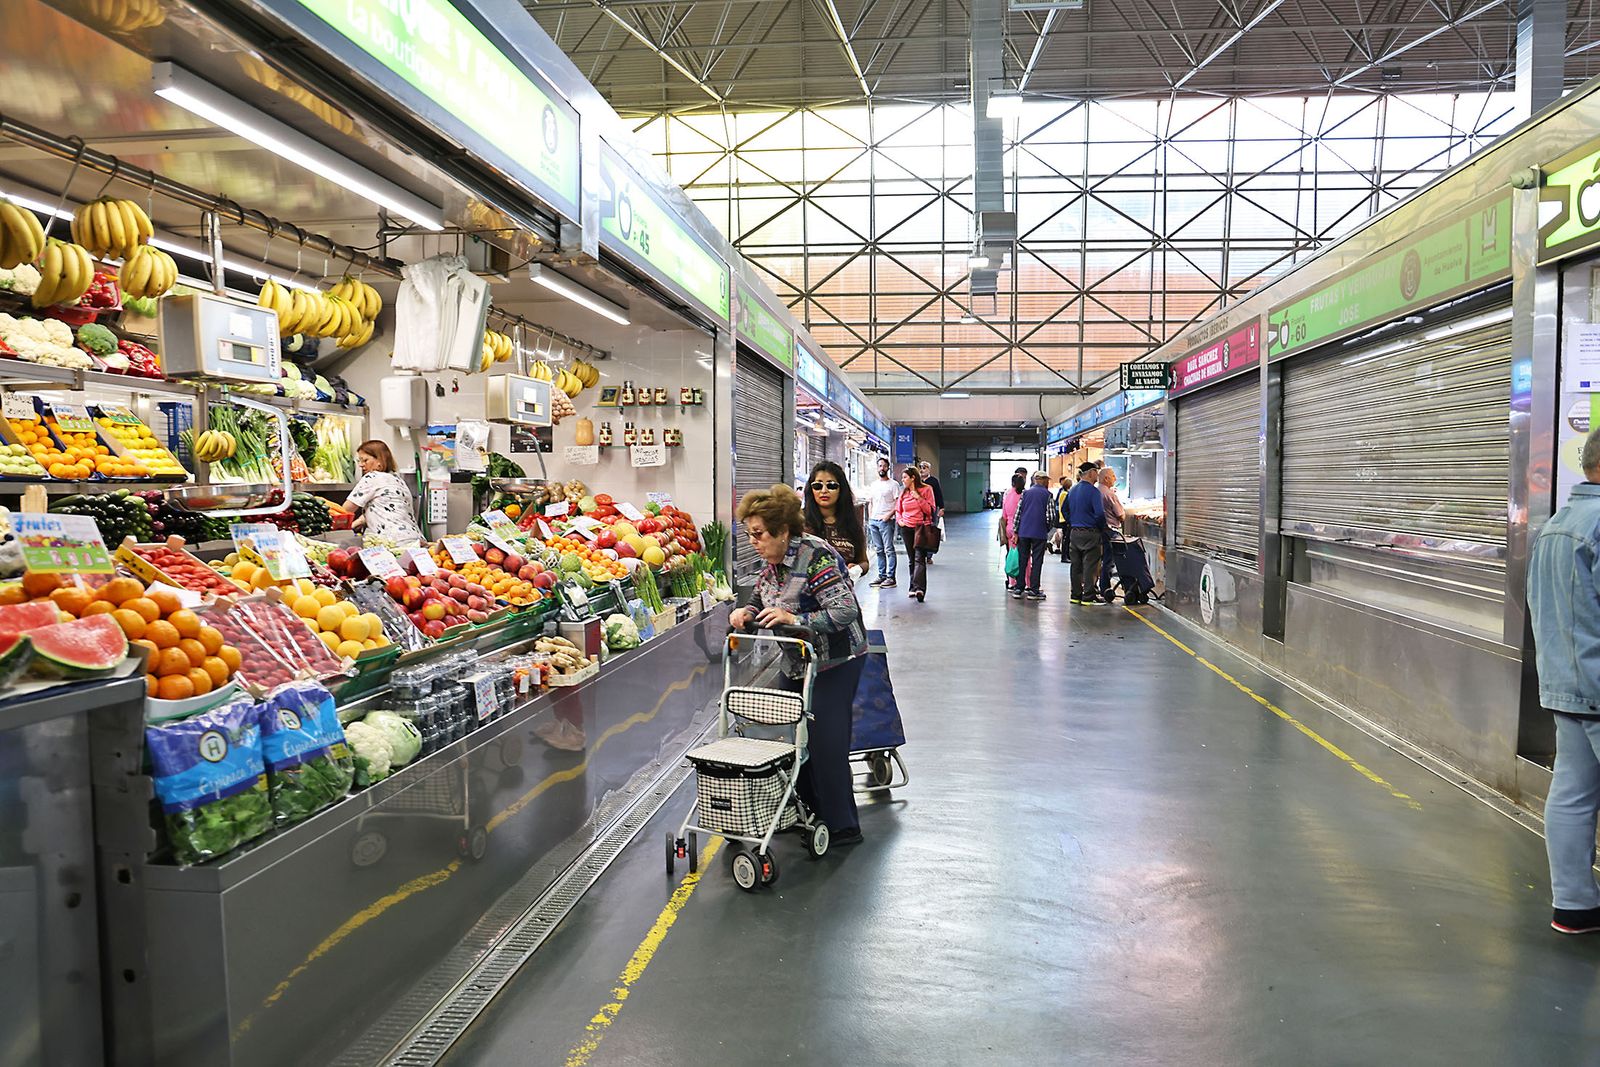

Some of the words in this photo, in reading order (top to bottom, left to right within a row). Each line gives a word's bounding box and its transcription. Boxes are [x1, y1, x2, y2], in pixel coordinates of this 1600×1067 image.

[347, 0, 369, 34] La
[371, 13, 444, 93] boutique
[456, 30, 472, 75] Y
[640, 229, 650, 255] 45
[1311, 286, 1340, 314] FRUTAS
[1296, 323, 1306, 342] 60
[1130, 363, 1159, 371] CORTAMOS
[1198, 347, 1219, 368] SÁNCHEZ
[1206, 361, 1222, 378] HUELVA
[208, 740, 221, 757] H
